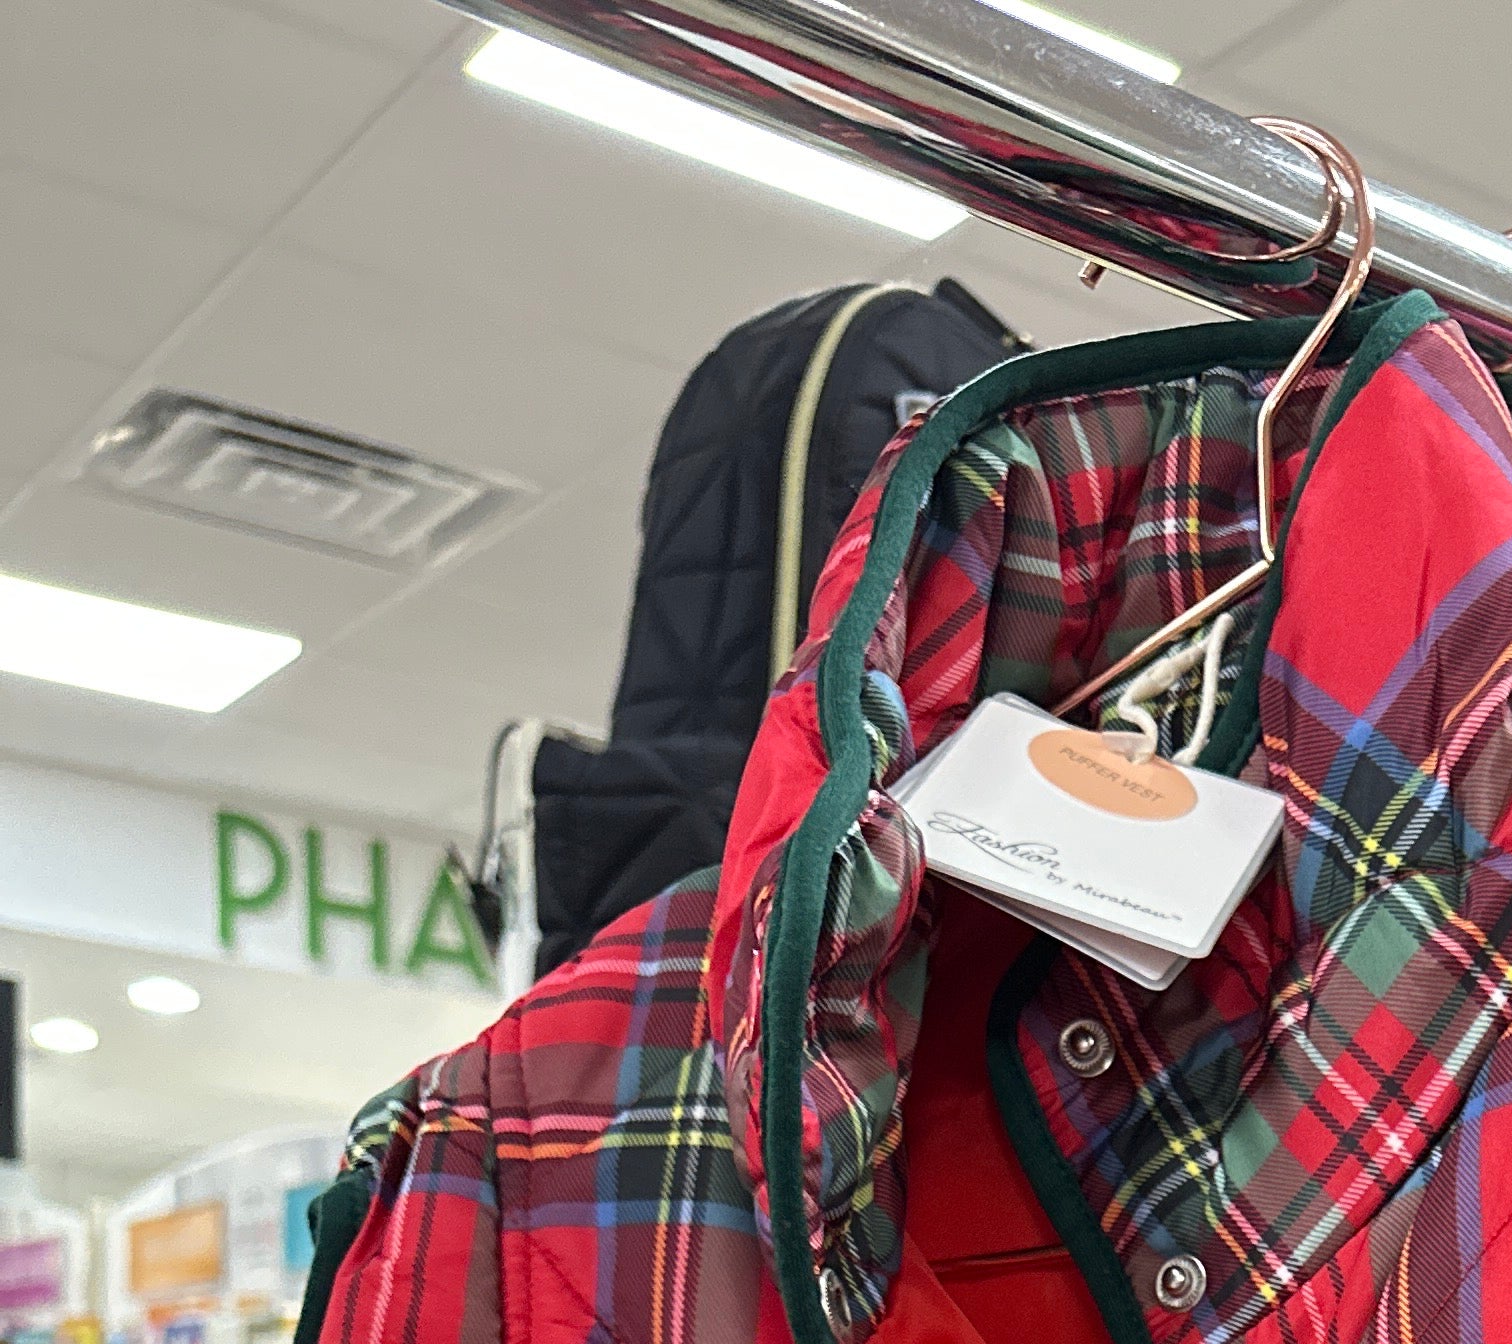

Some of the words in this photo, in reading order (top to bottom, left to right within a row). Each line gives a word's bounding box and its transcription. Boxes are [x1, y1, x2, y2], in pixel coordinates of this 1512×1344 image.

[1058, 747, 1121, 782] PUFFER
[1121, 778, 1166, 803] VEST
[927, 811, 1062, 875] Fashion
[1045, 872, 1067, 888] by
